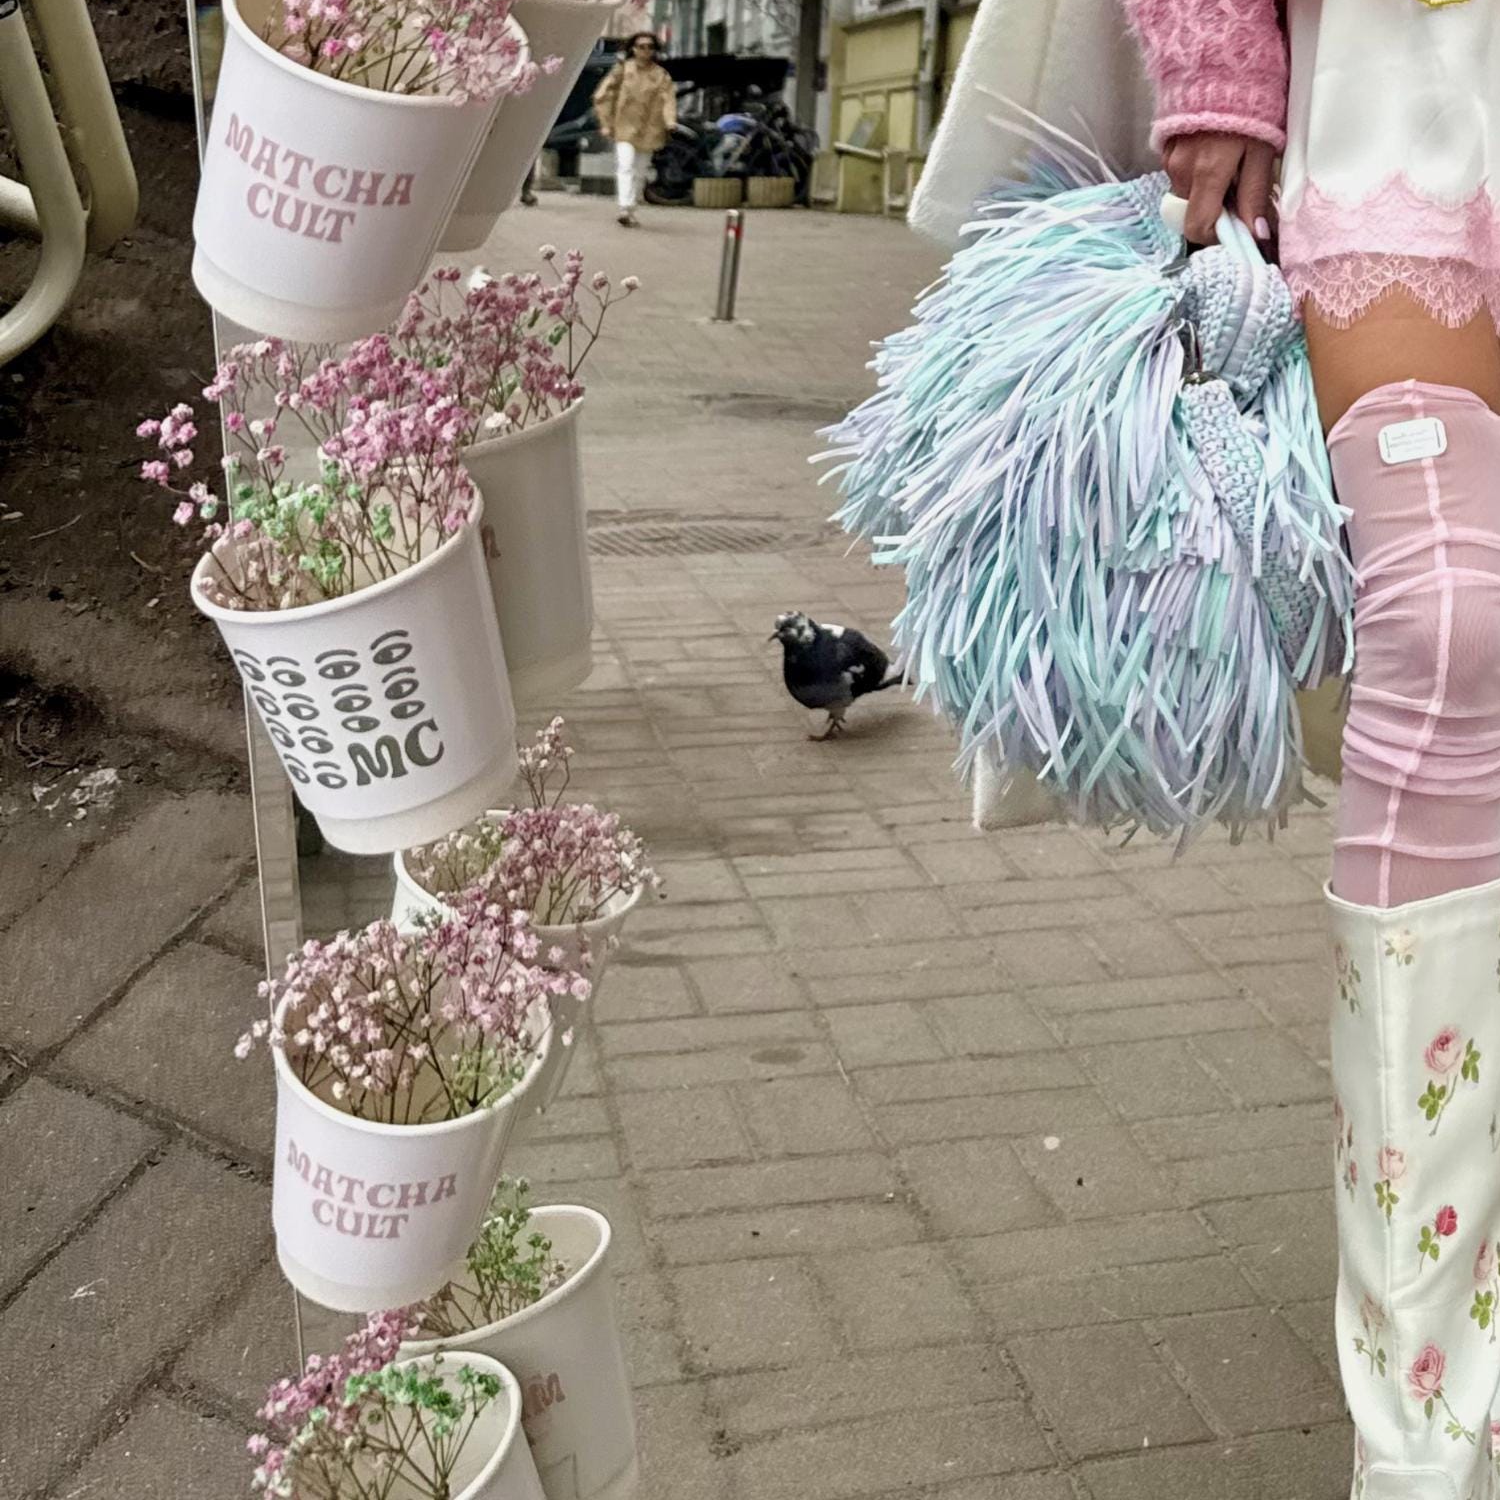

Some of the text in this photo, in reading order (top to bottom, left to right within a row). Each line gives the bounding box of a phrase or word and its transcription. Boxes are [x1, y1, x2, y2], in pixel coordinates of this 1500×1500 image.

[224, 112, 415, 207] MATCHA
[246, 181, 356, 245] CULT
[347, 716, 446, 788] MC
[286, 1139, 458, 1210] MATCHA
[311, 1198, 411, 1241] CULT
